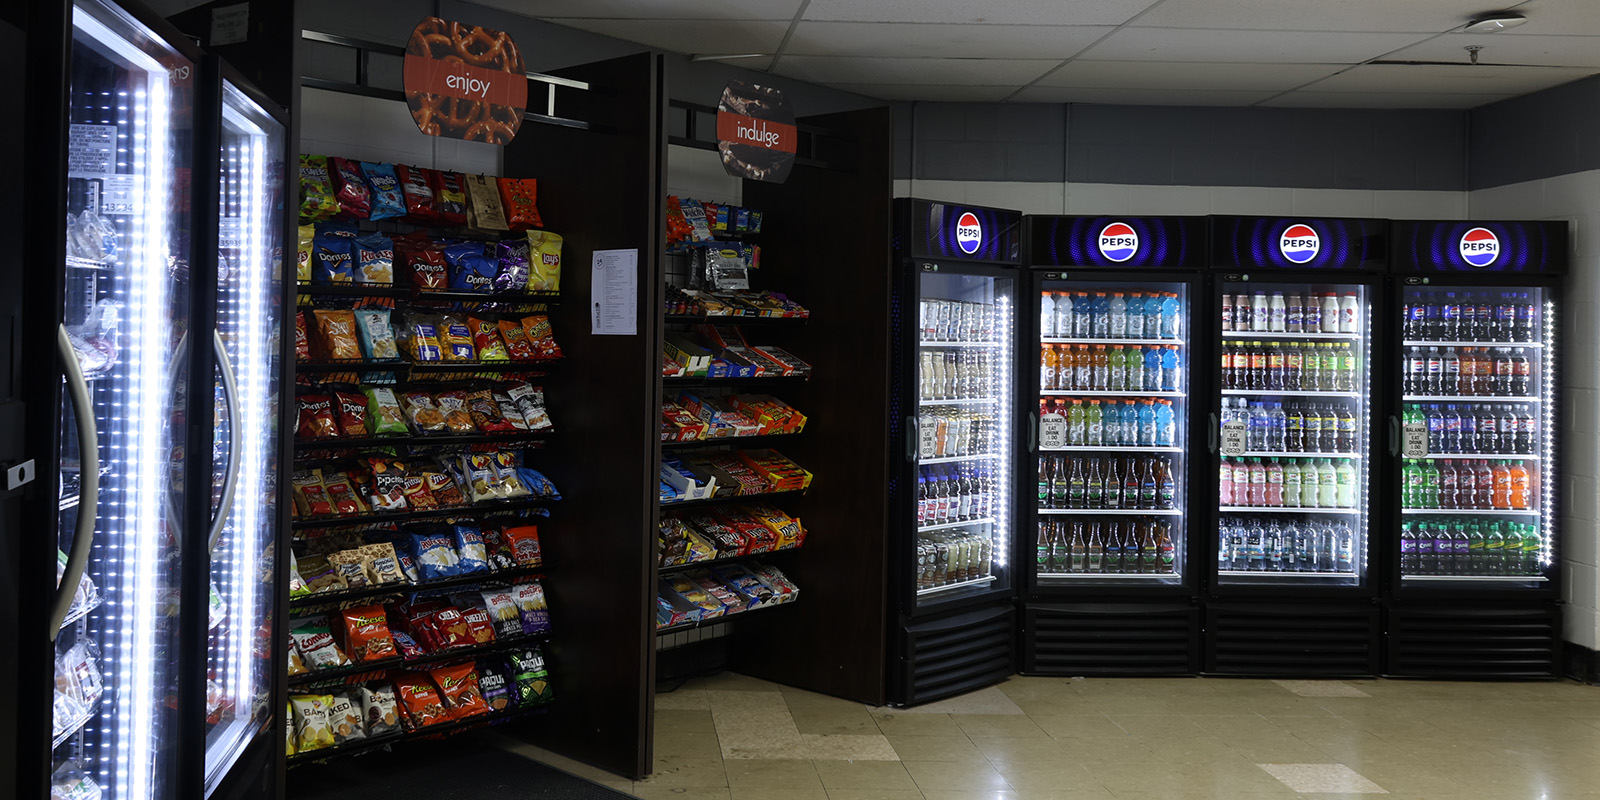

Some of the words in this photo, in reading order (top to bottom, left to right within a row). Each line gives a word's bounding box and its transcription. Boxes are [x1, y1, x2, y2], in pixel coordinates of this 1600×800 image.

[446, 72, 491, 99] enjoy
[736, 120, 780, 147] indulge
[958, 227, 980, 239] PEPSI
[1101, 236, 1136, 247] PEPSI
[1282, 238, 1318, 249] PEPSI
[1462, 241, 1497, 252] PEPSI
[318, 252, 351, 261] Doritos
[413, 263, 444, 272] Doritos
[466, 274, 492, 285] Doritos
[301, 400, 330, 410] Doritos
[356, 614, 386, 628] Reese's
[520, 656, 545, 670] PAQUI
[479, 674, 505, 688] PAQUI
